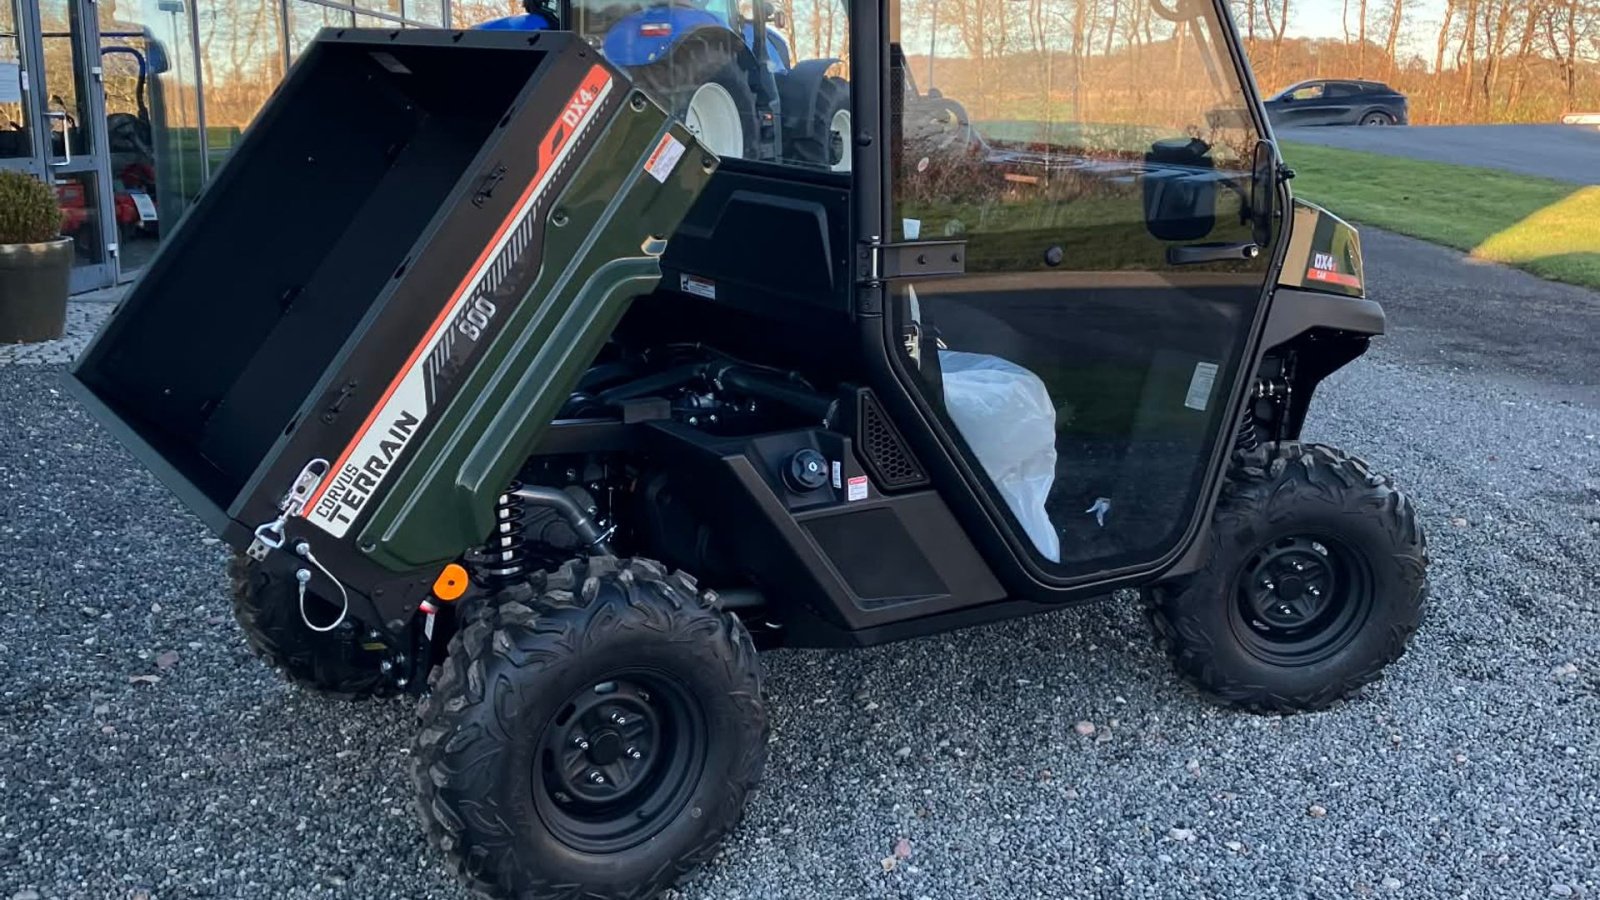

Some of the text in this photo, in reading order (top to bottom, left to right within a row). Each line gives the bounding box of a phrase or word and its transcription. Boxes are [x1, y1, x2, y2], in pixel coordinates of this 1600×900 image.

[459, 296, 496, 342] 800
[315, 463, 359, 519] CORVUS
[327, 410, 419, 524] TERRAIN
